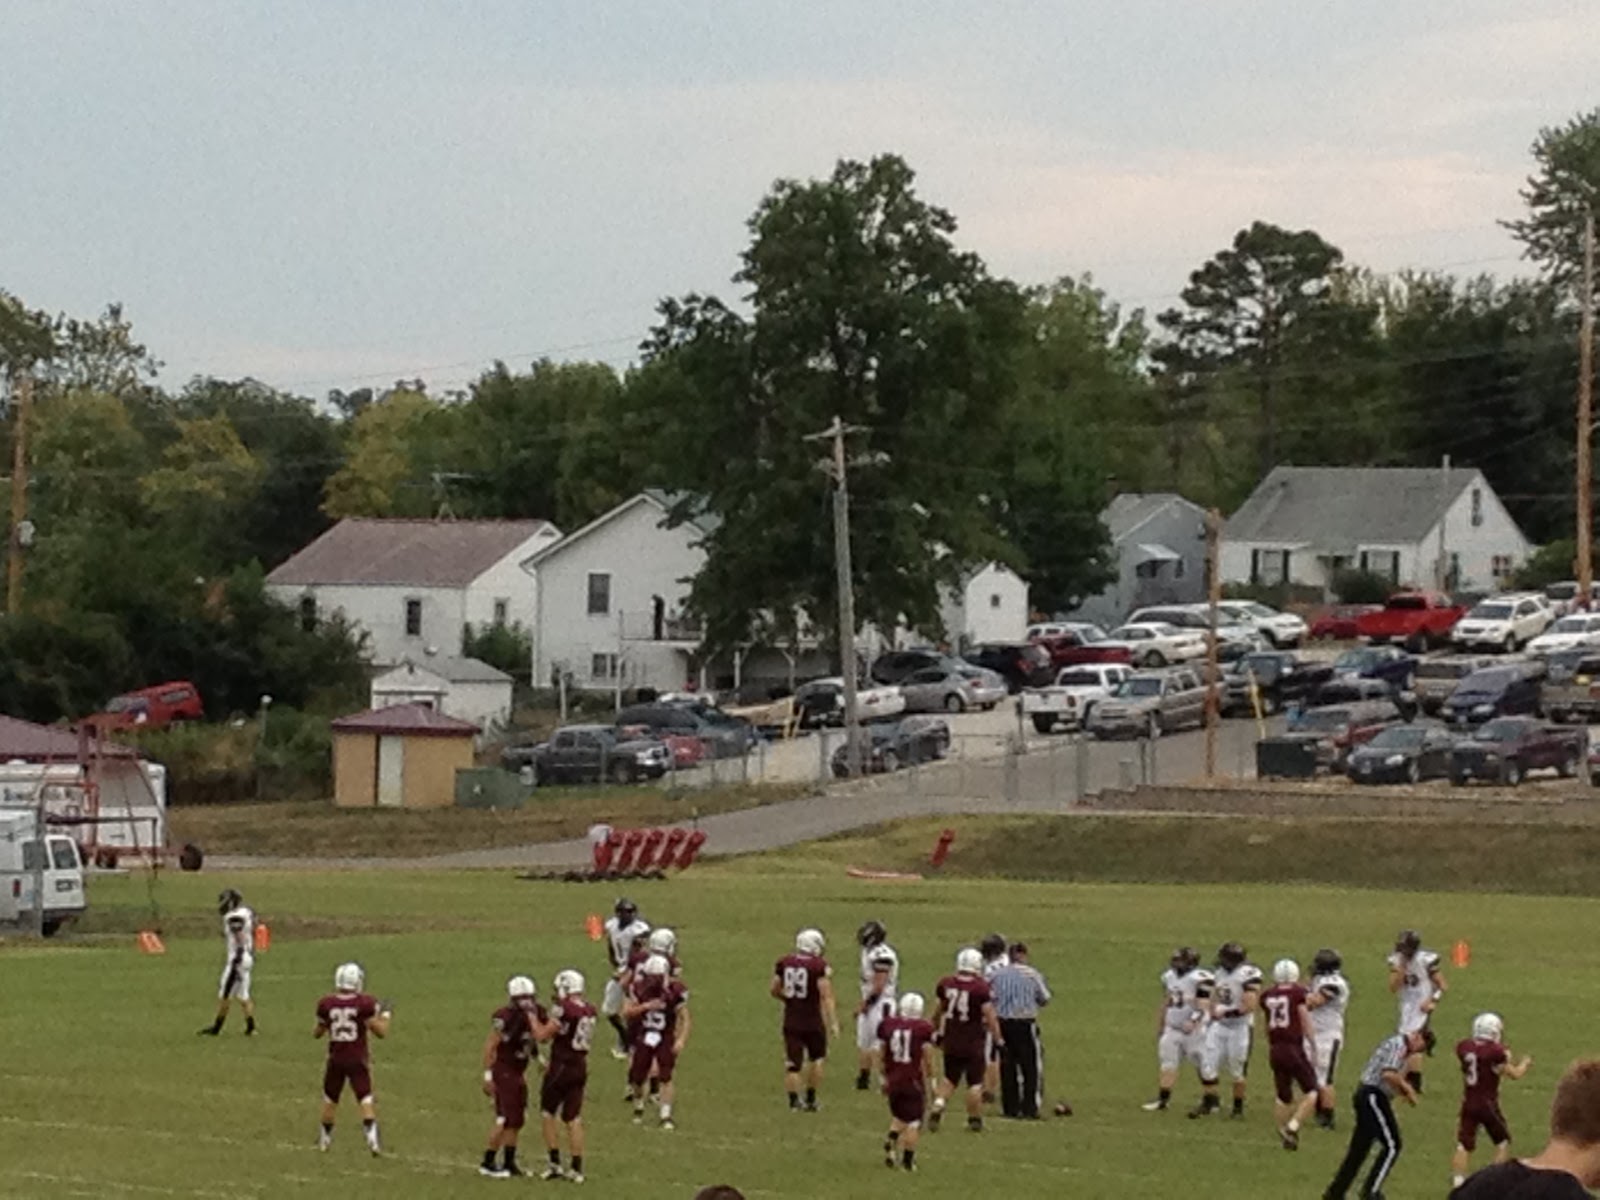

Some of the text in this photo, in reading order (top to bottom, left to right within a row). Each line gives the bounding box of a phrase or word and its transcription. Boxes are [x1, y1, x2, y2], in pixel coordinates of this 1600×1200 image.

[783, 967, 808, 998] 89
[946, 988, 970, 1021] 74
[328, 1008, 358, 1042] 25
[890, 1029, 912, 1063] 41
[1464, 1052, 1477, 1085] 3
